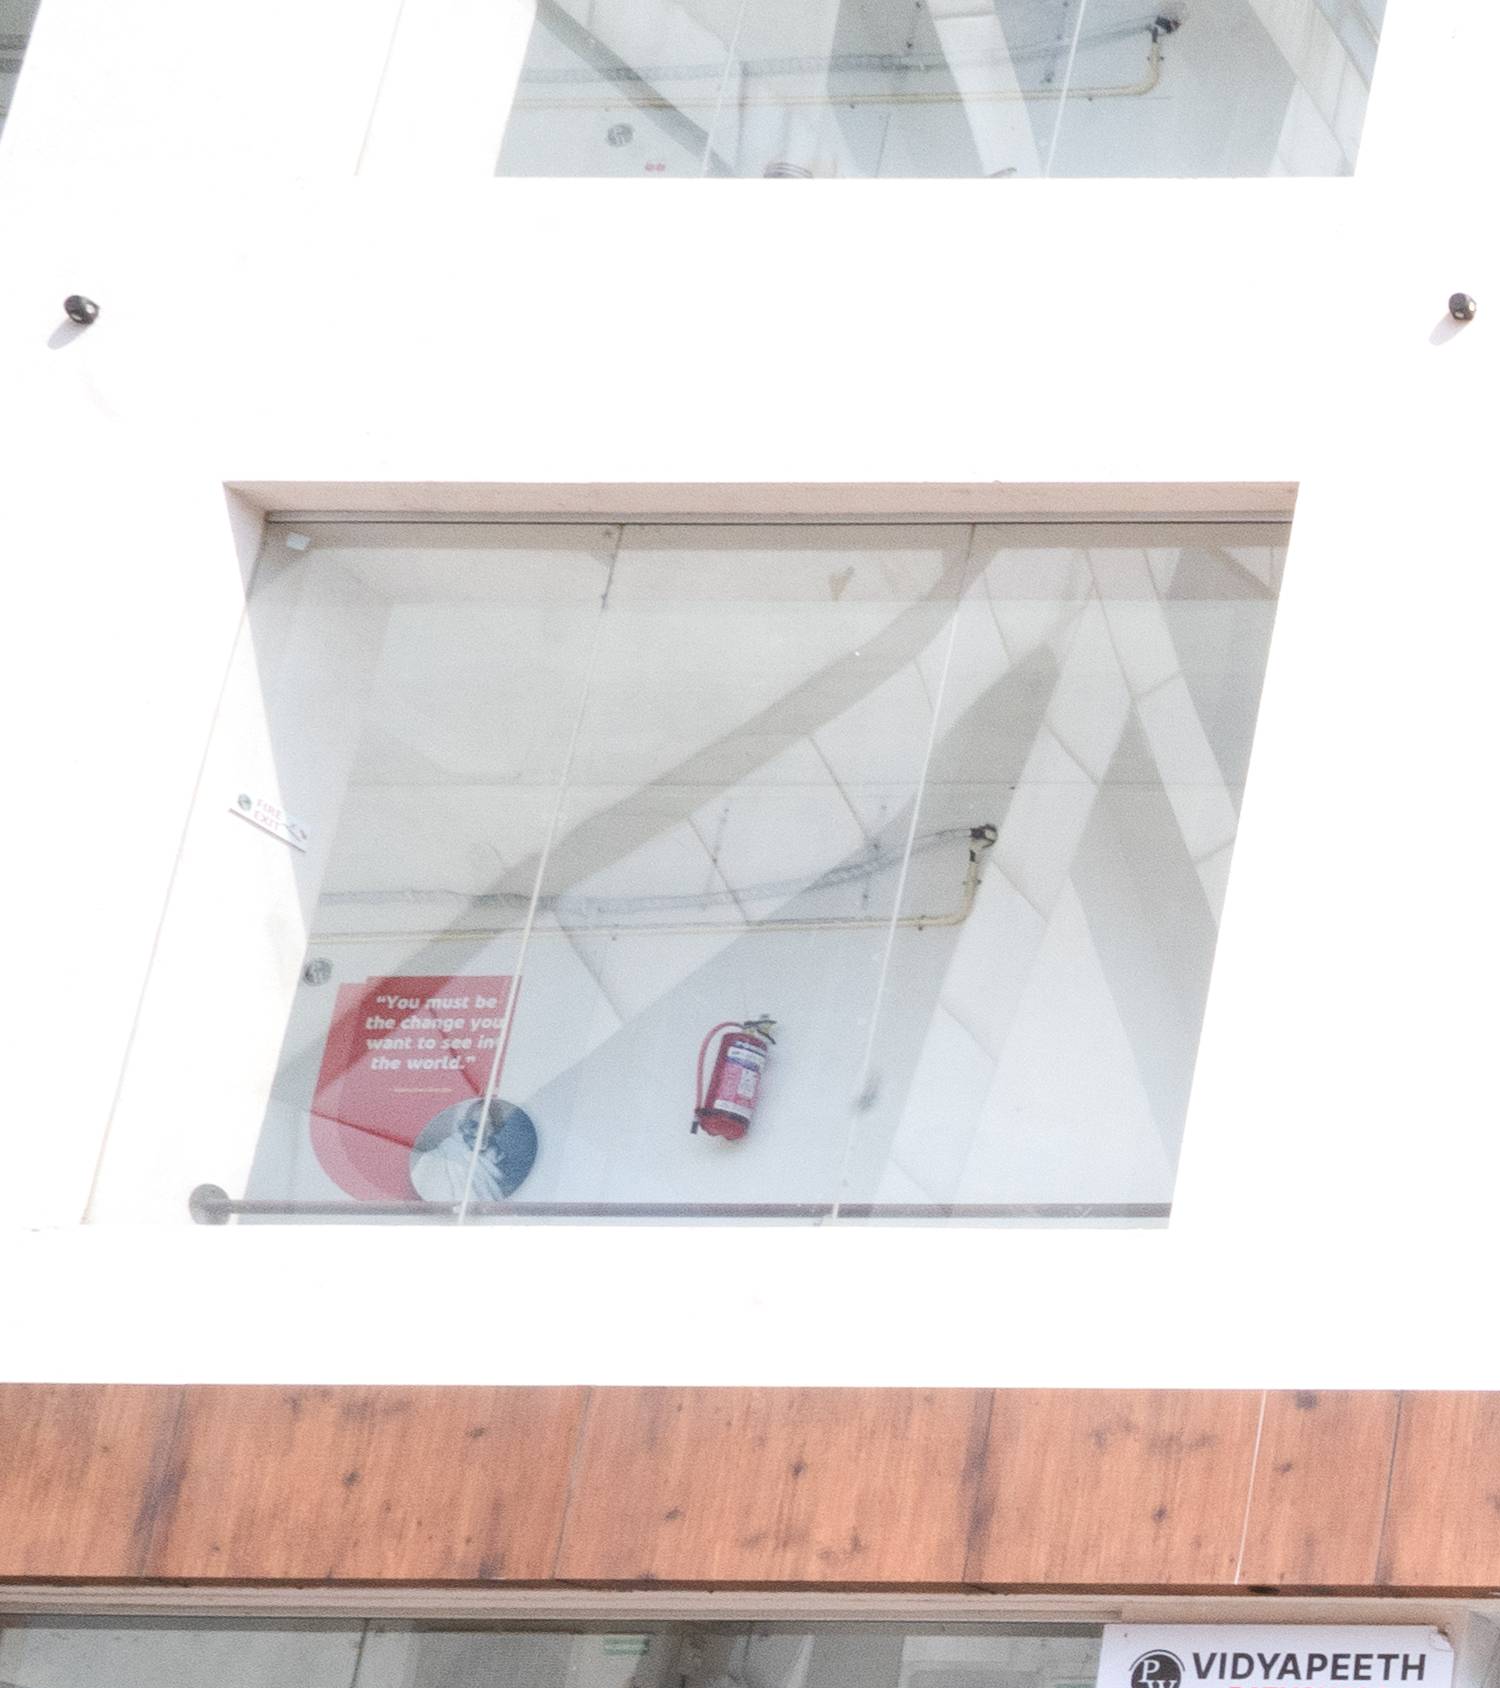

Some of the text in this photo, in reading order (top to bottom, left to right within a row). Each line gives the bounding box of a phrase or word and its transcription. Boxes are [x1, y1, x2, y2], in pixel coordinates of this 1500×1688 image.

[425, 995, 469, 1010] must
[474, 994, 497, 1009] be
[365, 1015, 465, 1032] the change
[366, 1036, 473, 1050] want to see
[370, 1055, 402, 1070] the
[1191, 1651, 1427, 1682] VIDYAPEETH
